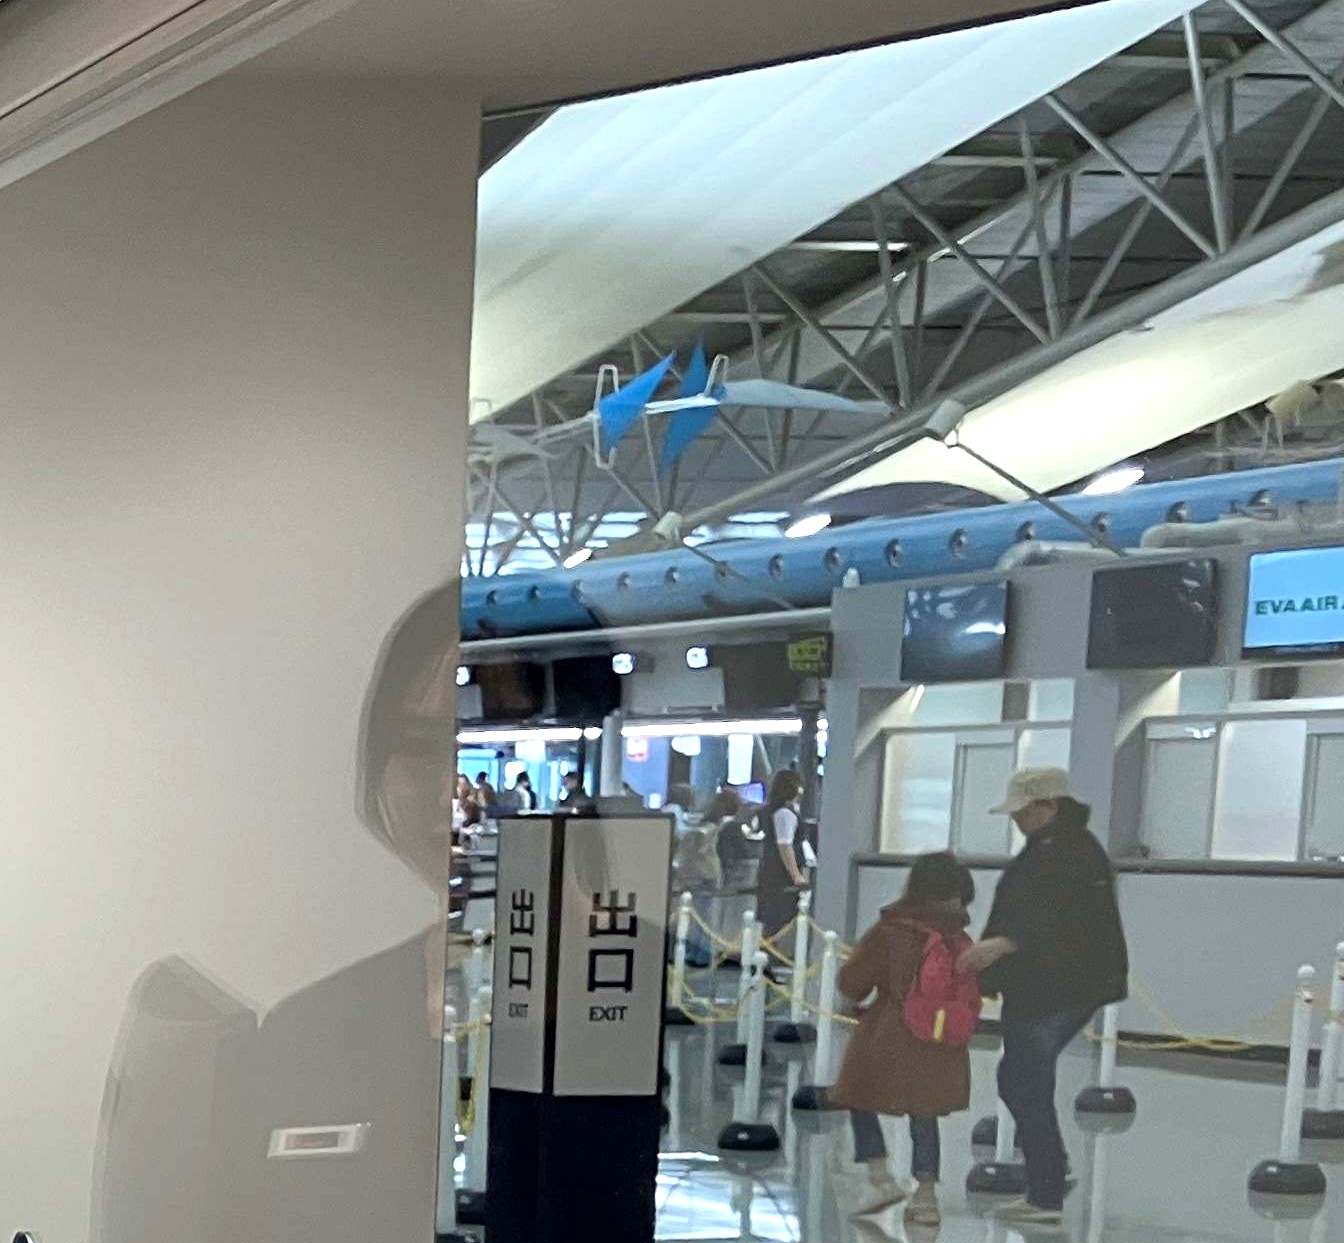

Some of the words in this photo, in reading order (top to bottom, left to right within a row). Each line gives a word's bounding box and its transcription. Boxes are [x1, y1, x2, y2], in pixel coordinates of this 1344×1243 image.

[508, 888, 534, 990] 出口
[588, 889, 638, 993] 出口
[588, 1005, 629, 1022] EXIT
